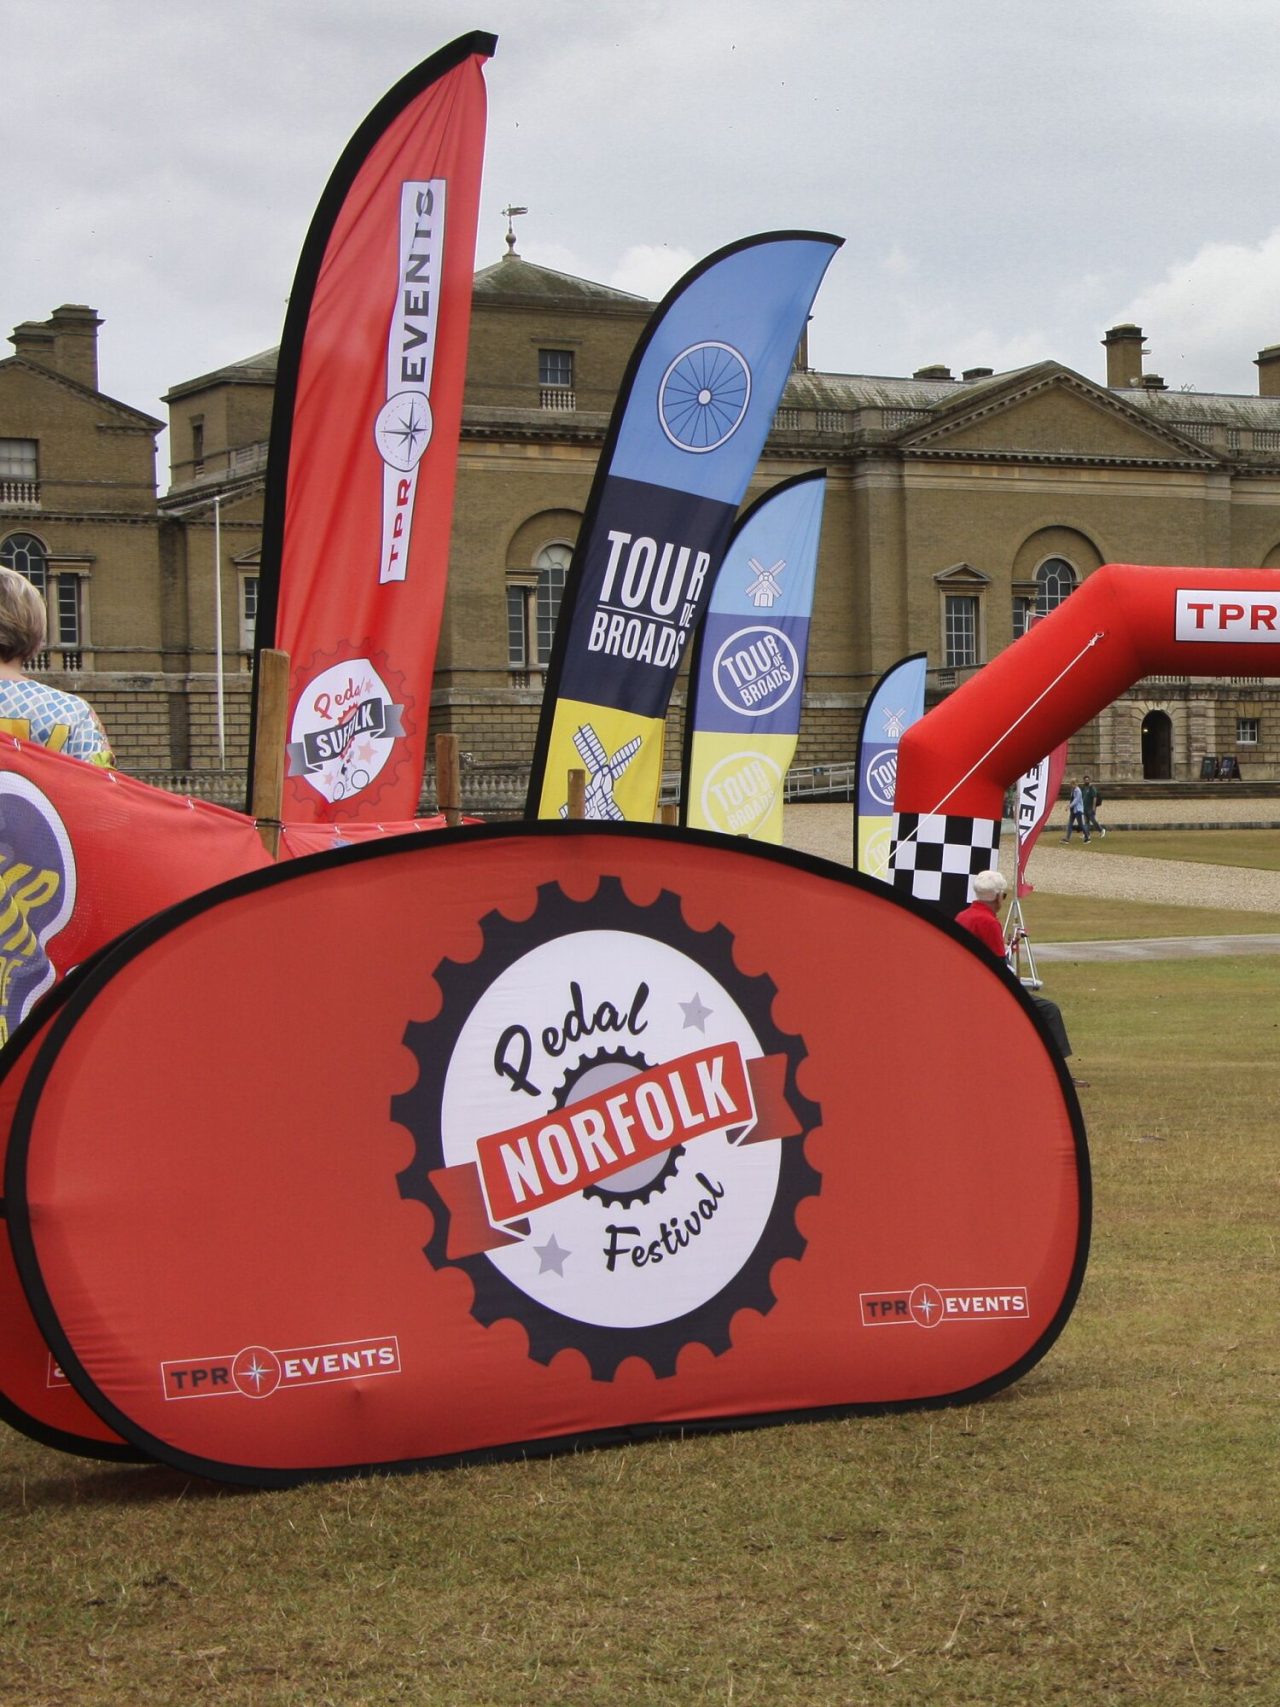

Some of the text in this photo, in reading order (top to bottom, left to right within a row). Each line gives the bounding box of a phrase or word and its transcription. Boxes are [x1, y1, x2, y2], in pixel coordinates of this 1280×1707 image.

[388, 188, 435, 571] TPR EVENTS
[600, 530, 710, 616] TOUR
[588, 611, 686, 670] BROADS
[679, 602, 696, 628] DE
[1187, 602, 1278, 631] TPR
[721, 634, 779, 688] TOUR
[739, 664, 792, 707] BROADS
[314, 677, 366, 720] Pedal
[494, 980, 650, 1097] Pedal
[499, 1055, 738, 1204] NORFOLK
[603, 1171, 726, 1272] Festival
[866, 1296, 1025, 1317] TPR EVENTS
[170, 1347, 395, 1390] TPR EVENTS
